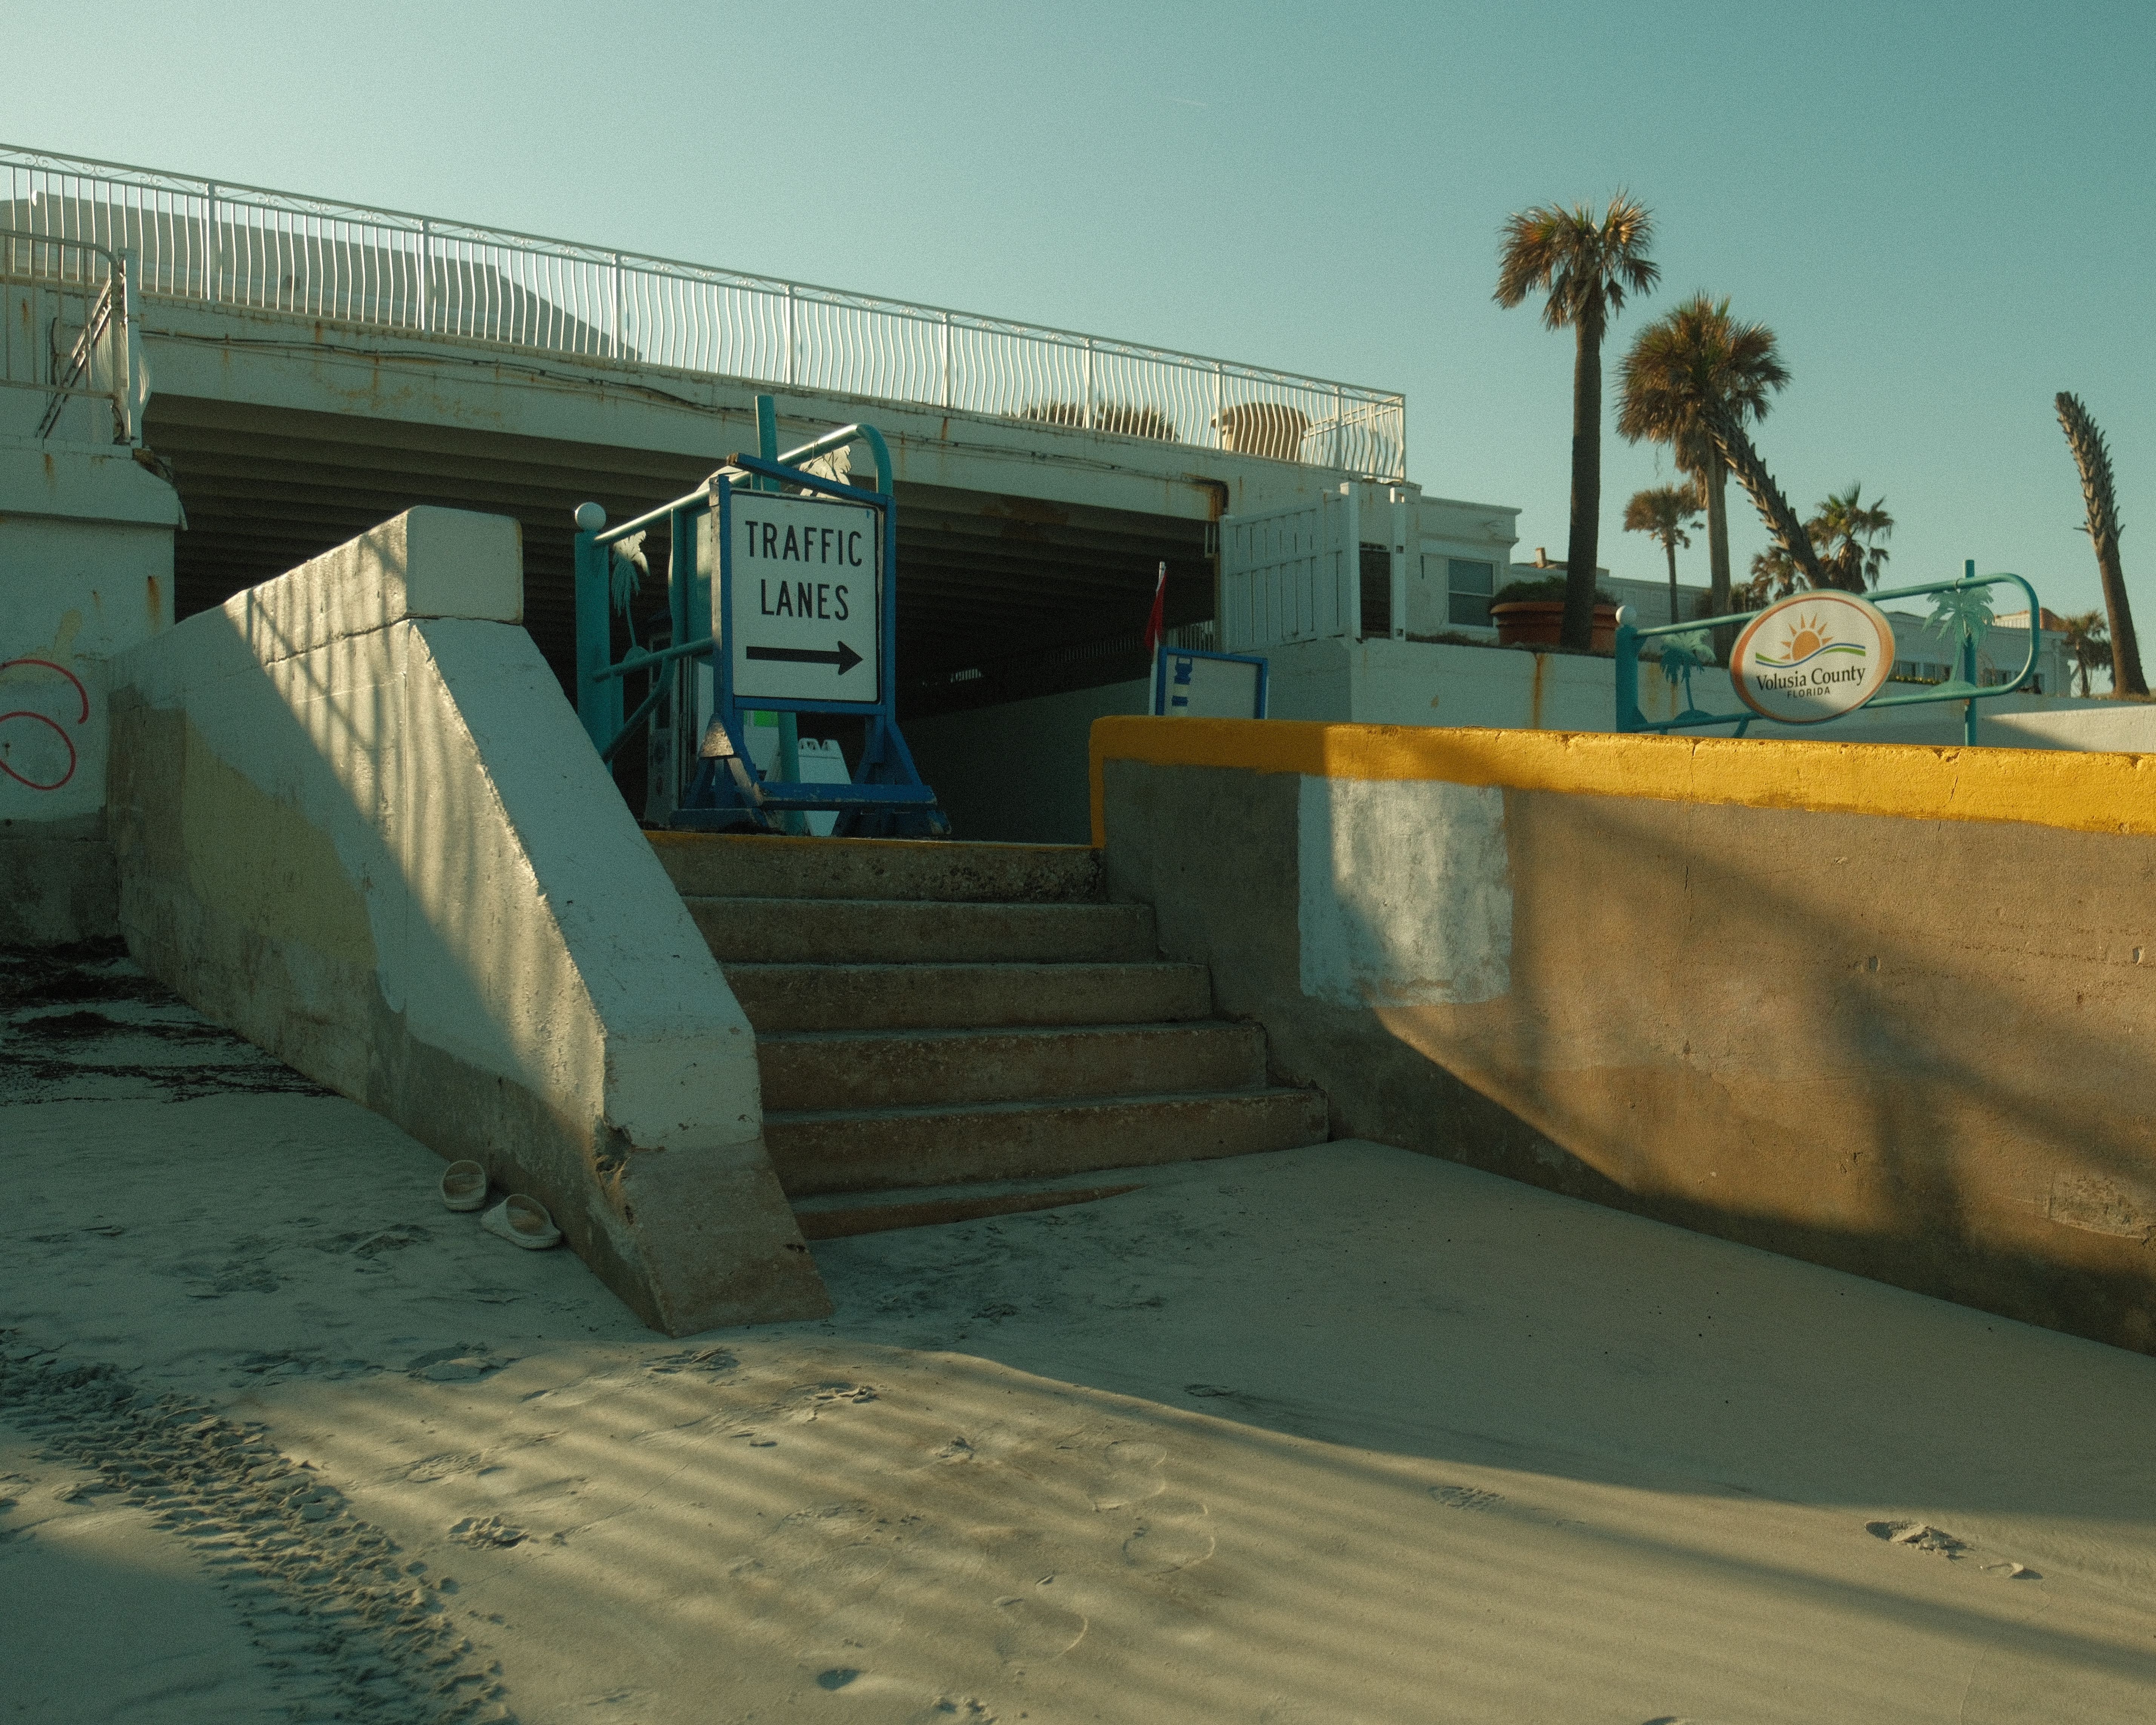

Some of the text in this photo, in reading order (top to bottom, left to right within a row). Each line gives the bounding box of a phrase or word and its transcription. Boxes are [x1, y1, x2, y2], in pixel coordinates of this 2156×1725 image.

[745, 520, 863, 567] TRAFFIC
[760, 579, 849, 621] LANES
[1756, 666, 1865, 691] Volusia County
[1787, 686, 1830, 699] FLORIDA
